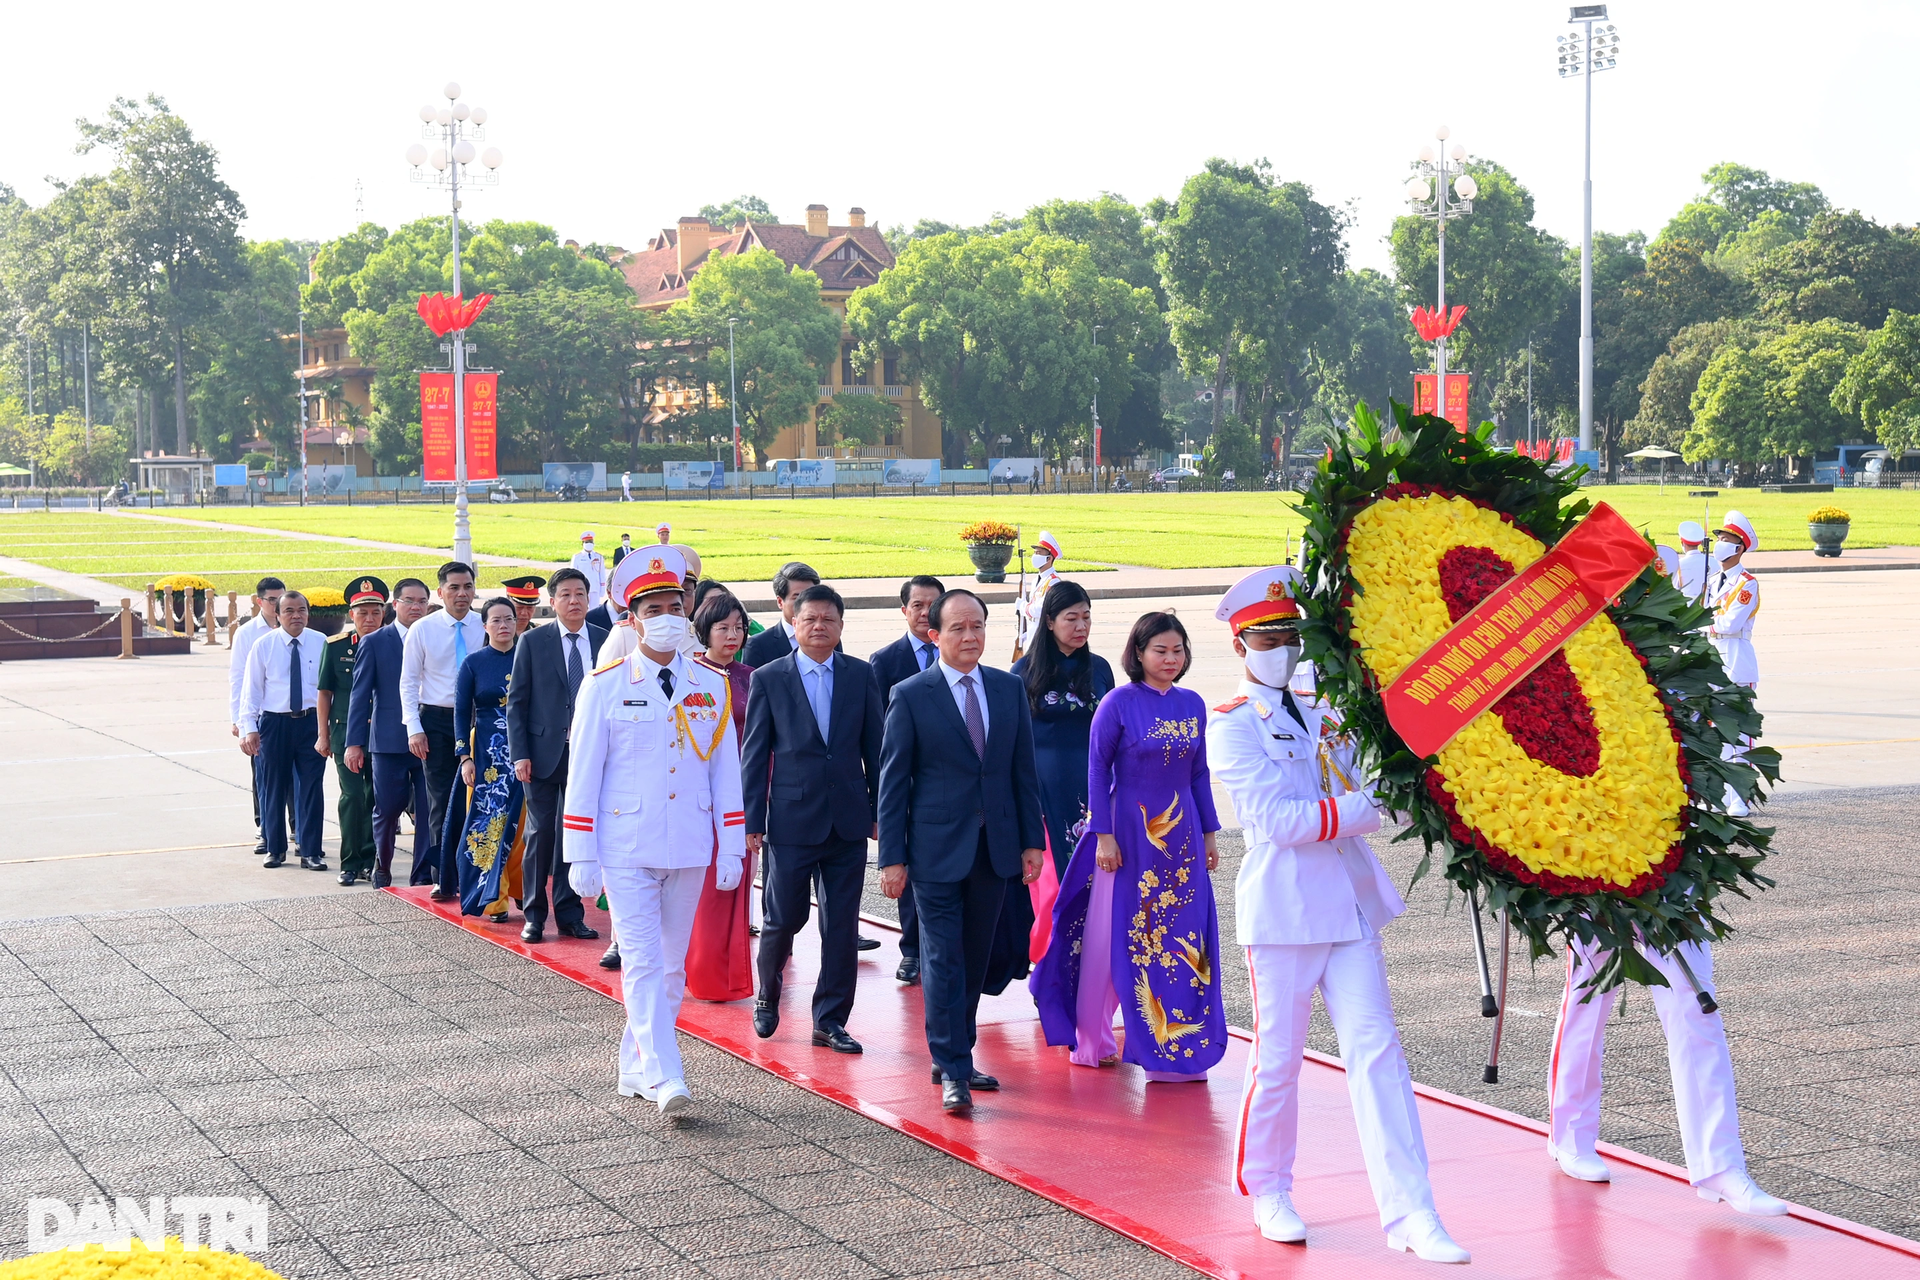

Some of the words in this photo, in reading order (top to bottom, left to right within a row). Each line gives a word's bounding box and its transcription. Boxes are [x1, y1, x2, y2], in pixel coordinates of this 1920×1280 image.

[425, 387, 450, 402] 27-7
[1519, 582, 1547, 612] CHÍ
[1529, 575, 1562, 602] MINH
[1489, 604, 1524, 634] TỊCH
[1507, 589, 1534, 621] HỒ
[1472, 614, 1507, 649] CHỦ
[1437, 643, 1475, 677] NHỚ
[1458, 635, 1489, 660] ƠN
[1420, 664, 1457, 692] ĐỜI
[1446, 684, 1481, 714] THÀNH
[1499, 646, 1531, 670] UBND,
[1539, 617, 1562, 637] VIỆT
[1403, 679, 1440, 706] ĐỜI
